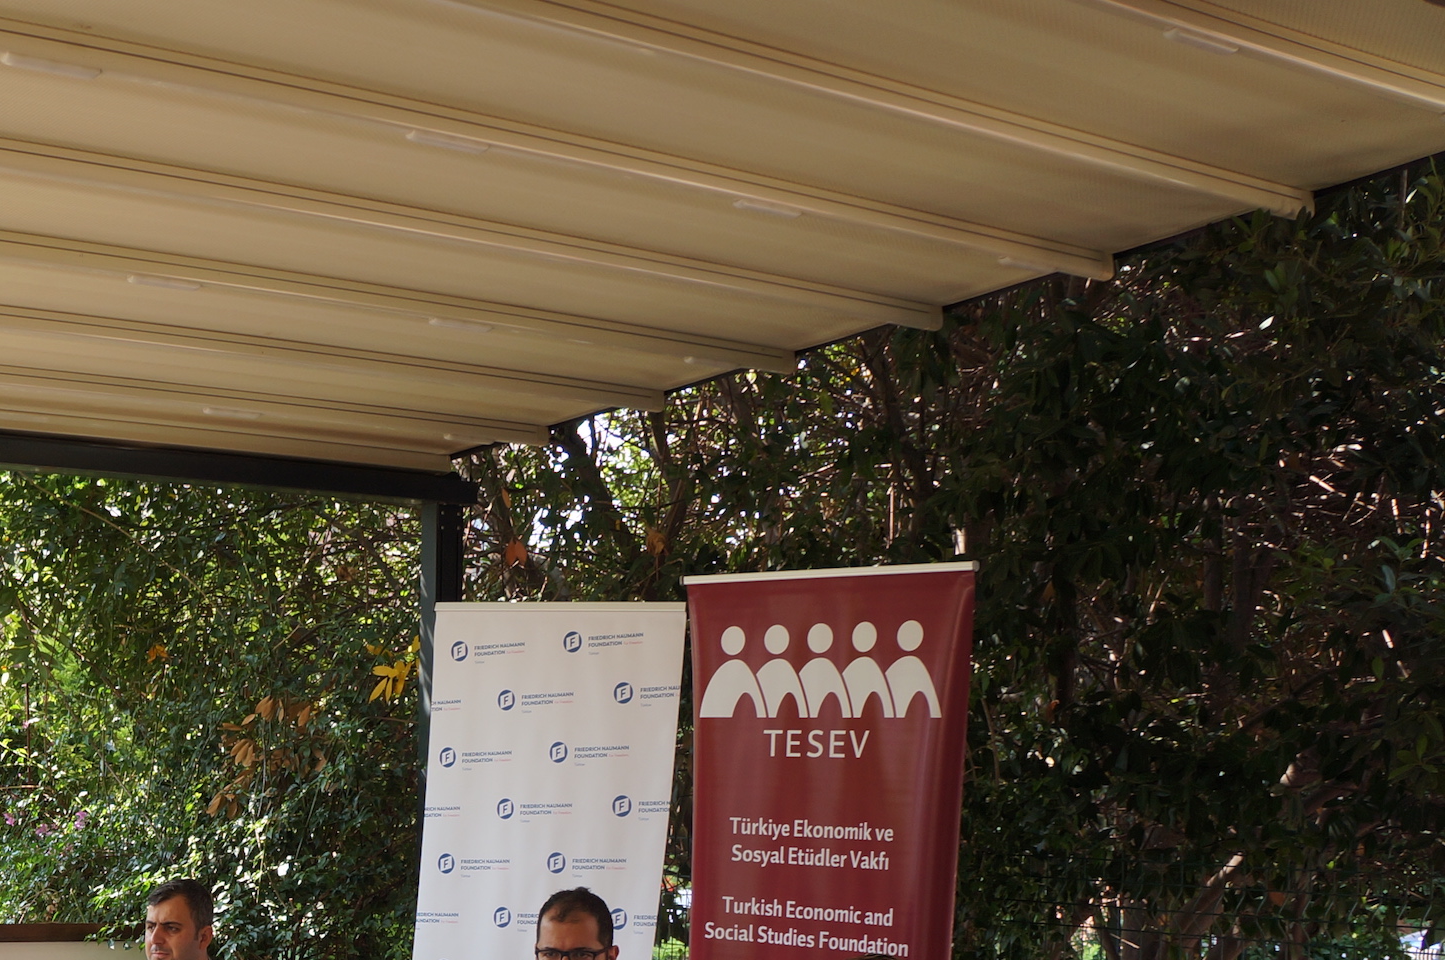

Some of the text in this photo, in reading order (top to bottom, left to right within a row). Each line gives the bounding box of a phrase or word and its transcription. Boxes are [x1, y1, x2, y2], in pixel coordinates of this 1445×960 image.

[763, 729, 870, 758] TESEV
[729, 816, 894, 842] Türkiye Ekonomik ve
[731, 844, 890, 870] Sosyal Etüdler Vakfı
[722, 895, 894, 927] Turkish Economic and
[704, 921, 909, 957] Social Studies Foundation
